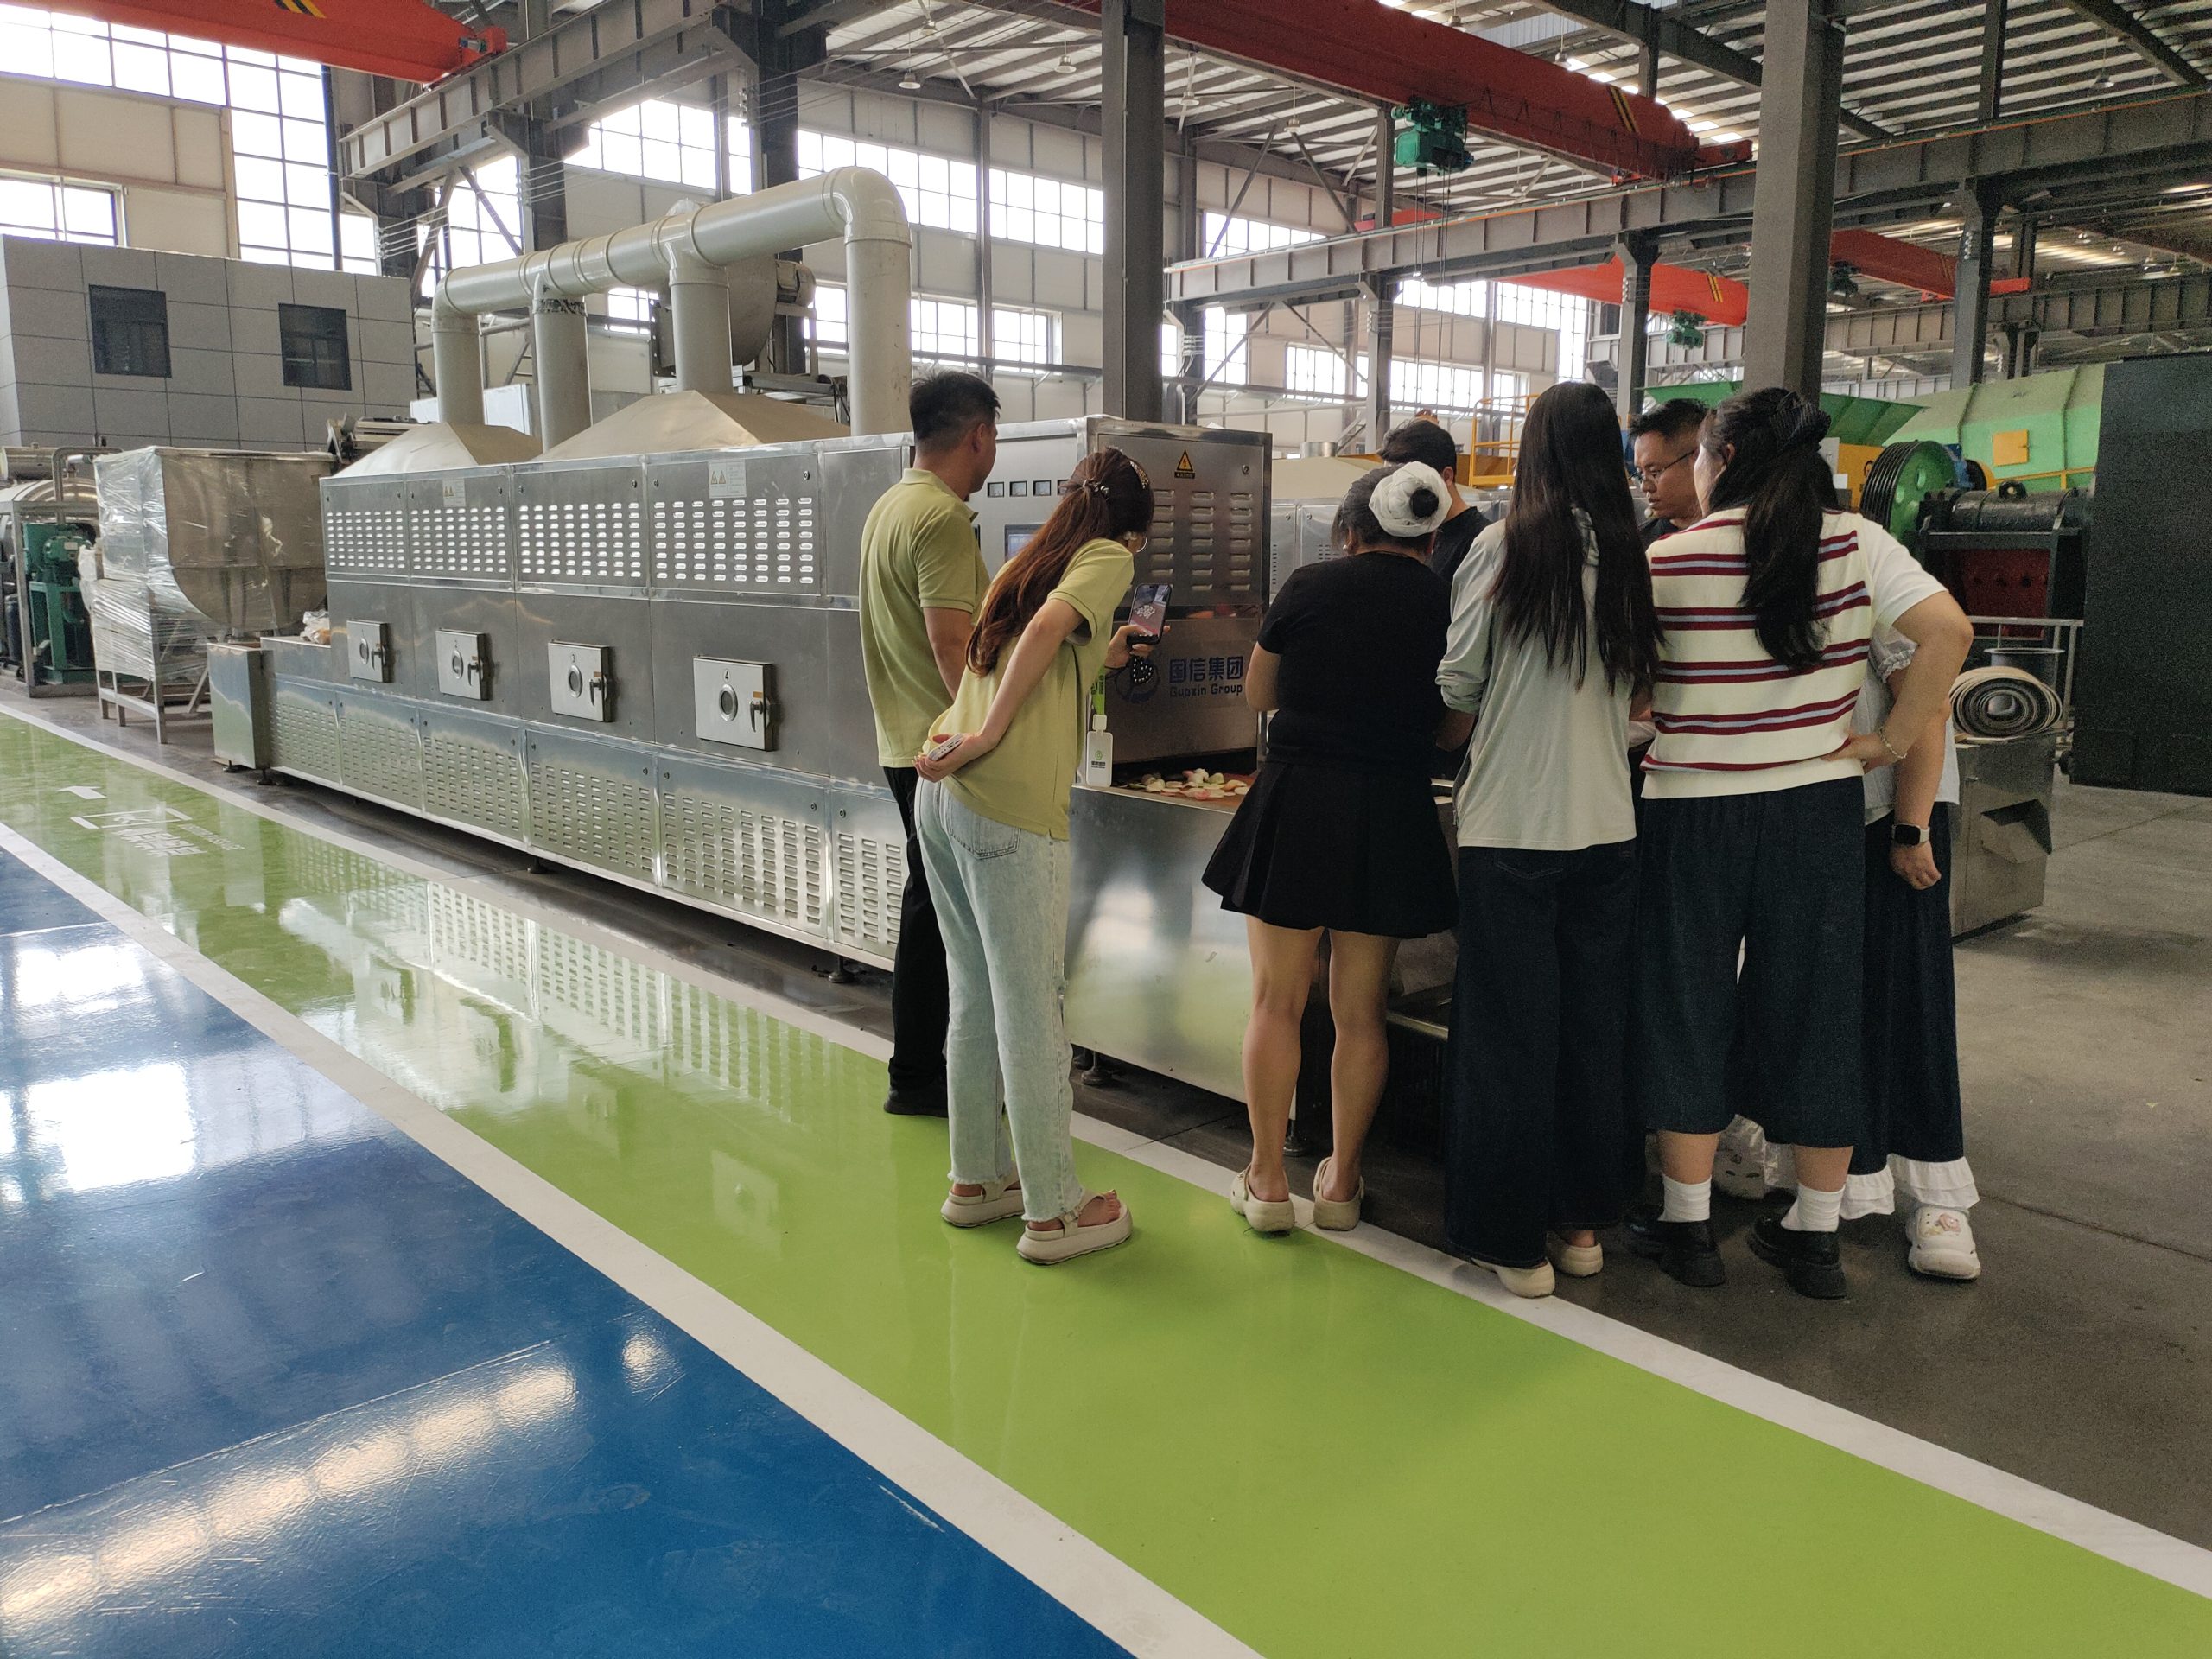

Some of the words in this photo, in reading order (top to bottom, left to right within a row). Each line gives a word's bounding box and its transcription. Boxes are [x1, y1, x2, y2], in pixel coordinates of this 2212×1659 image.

[1169, 657, 1243, 683] 国信集团
[1211, 683, 1243, 696] Group
